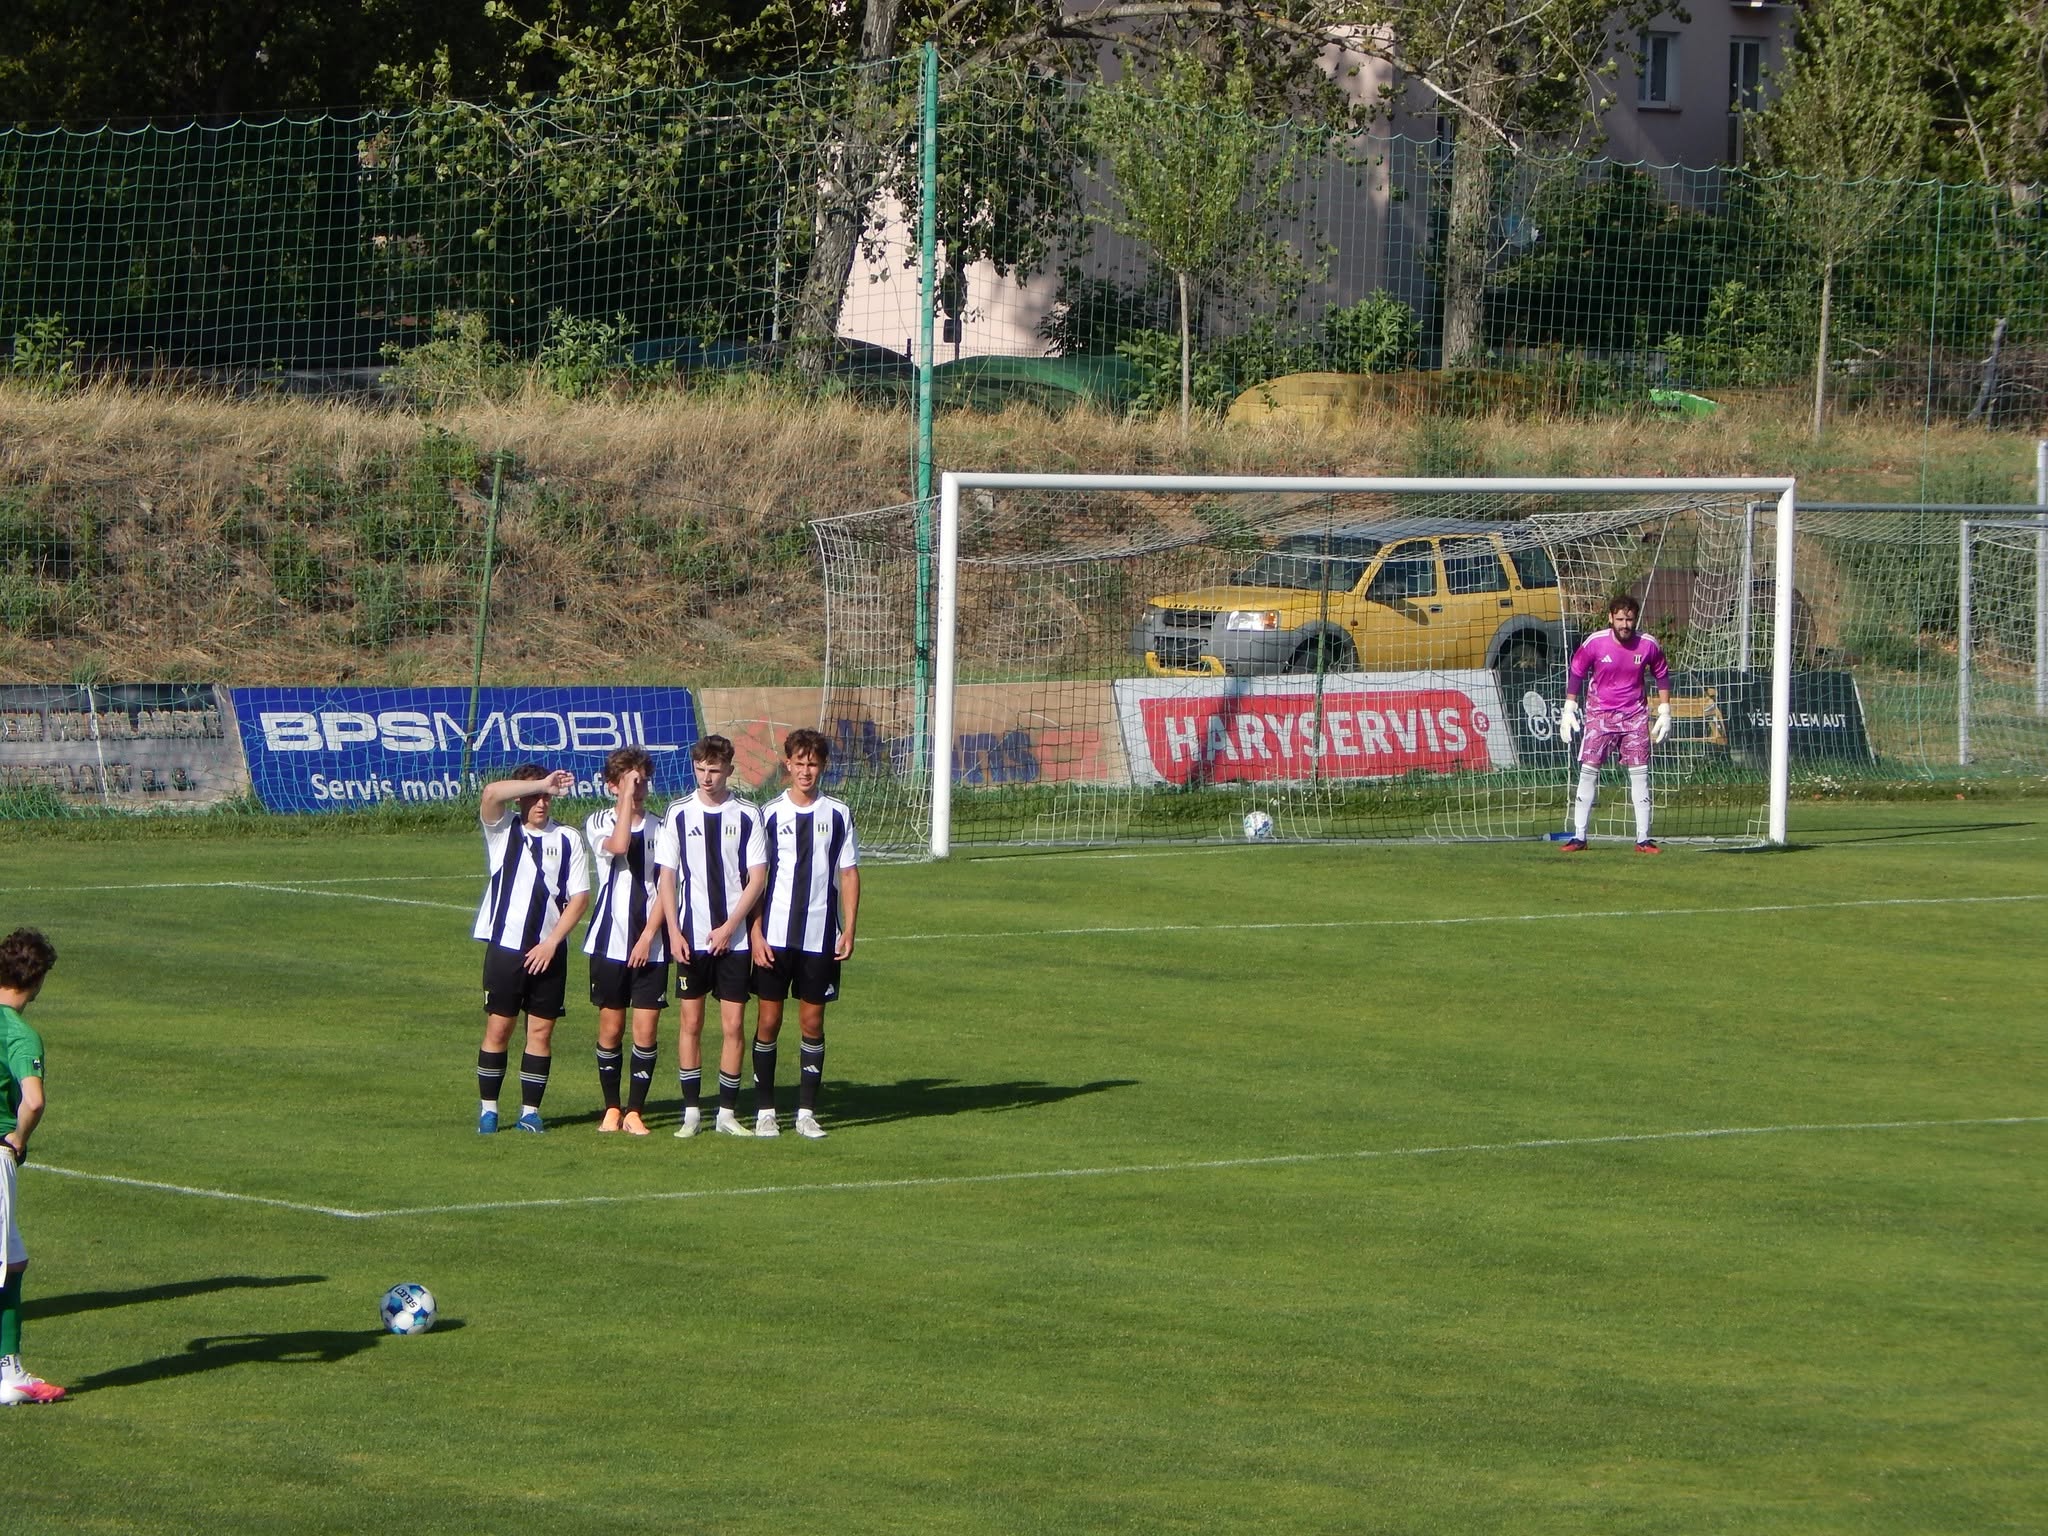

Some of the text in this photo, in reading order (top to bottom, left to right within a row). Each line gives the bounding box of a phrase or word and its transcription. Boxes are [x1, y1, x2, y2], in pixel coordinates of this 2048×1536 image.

[259, 711, 679, 752] BPSMOBIL
[1823, 712, 1846, 728] AUT
[311, 773, 395, 801] Servis
